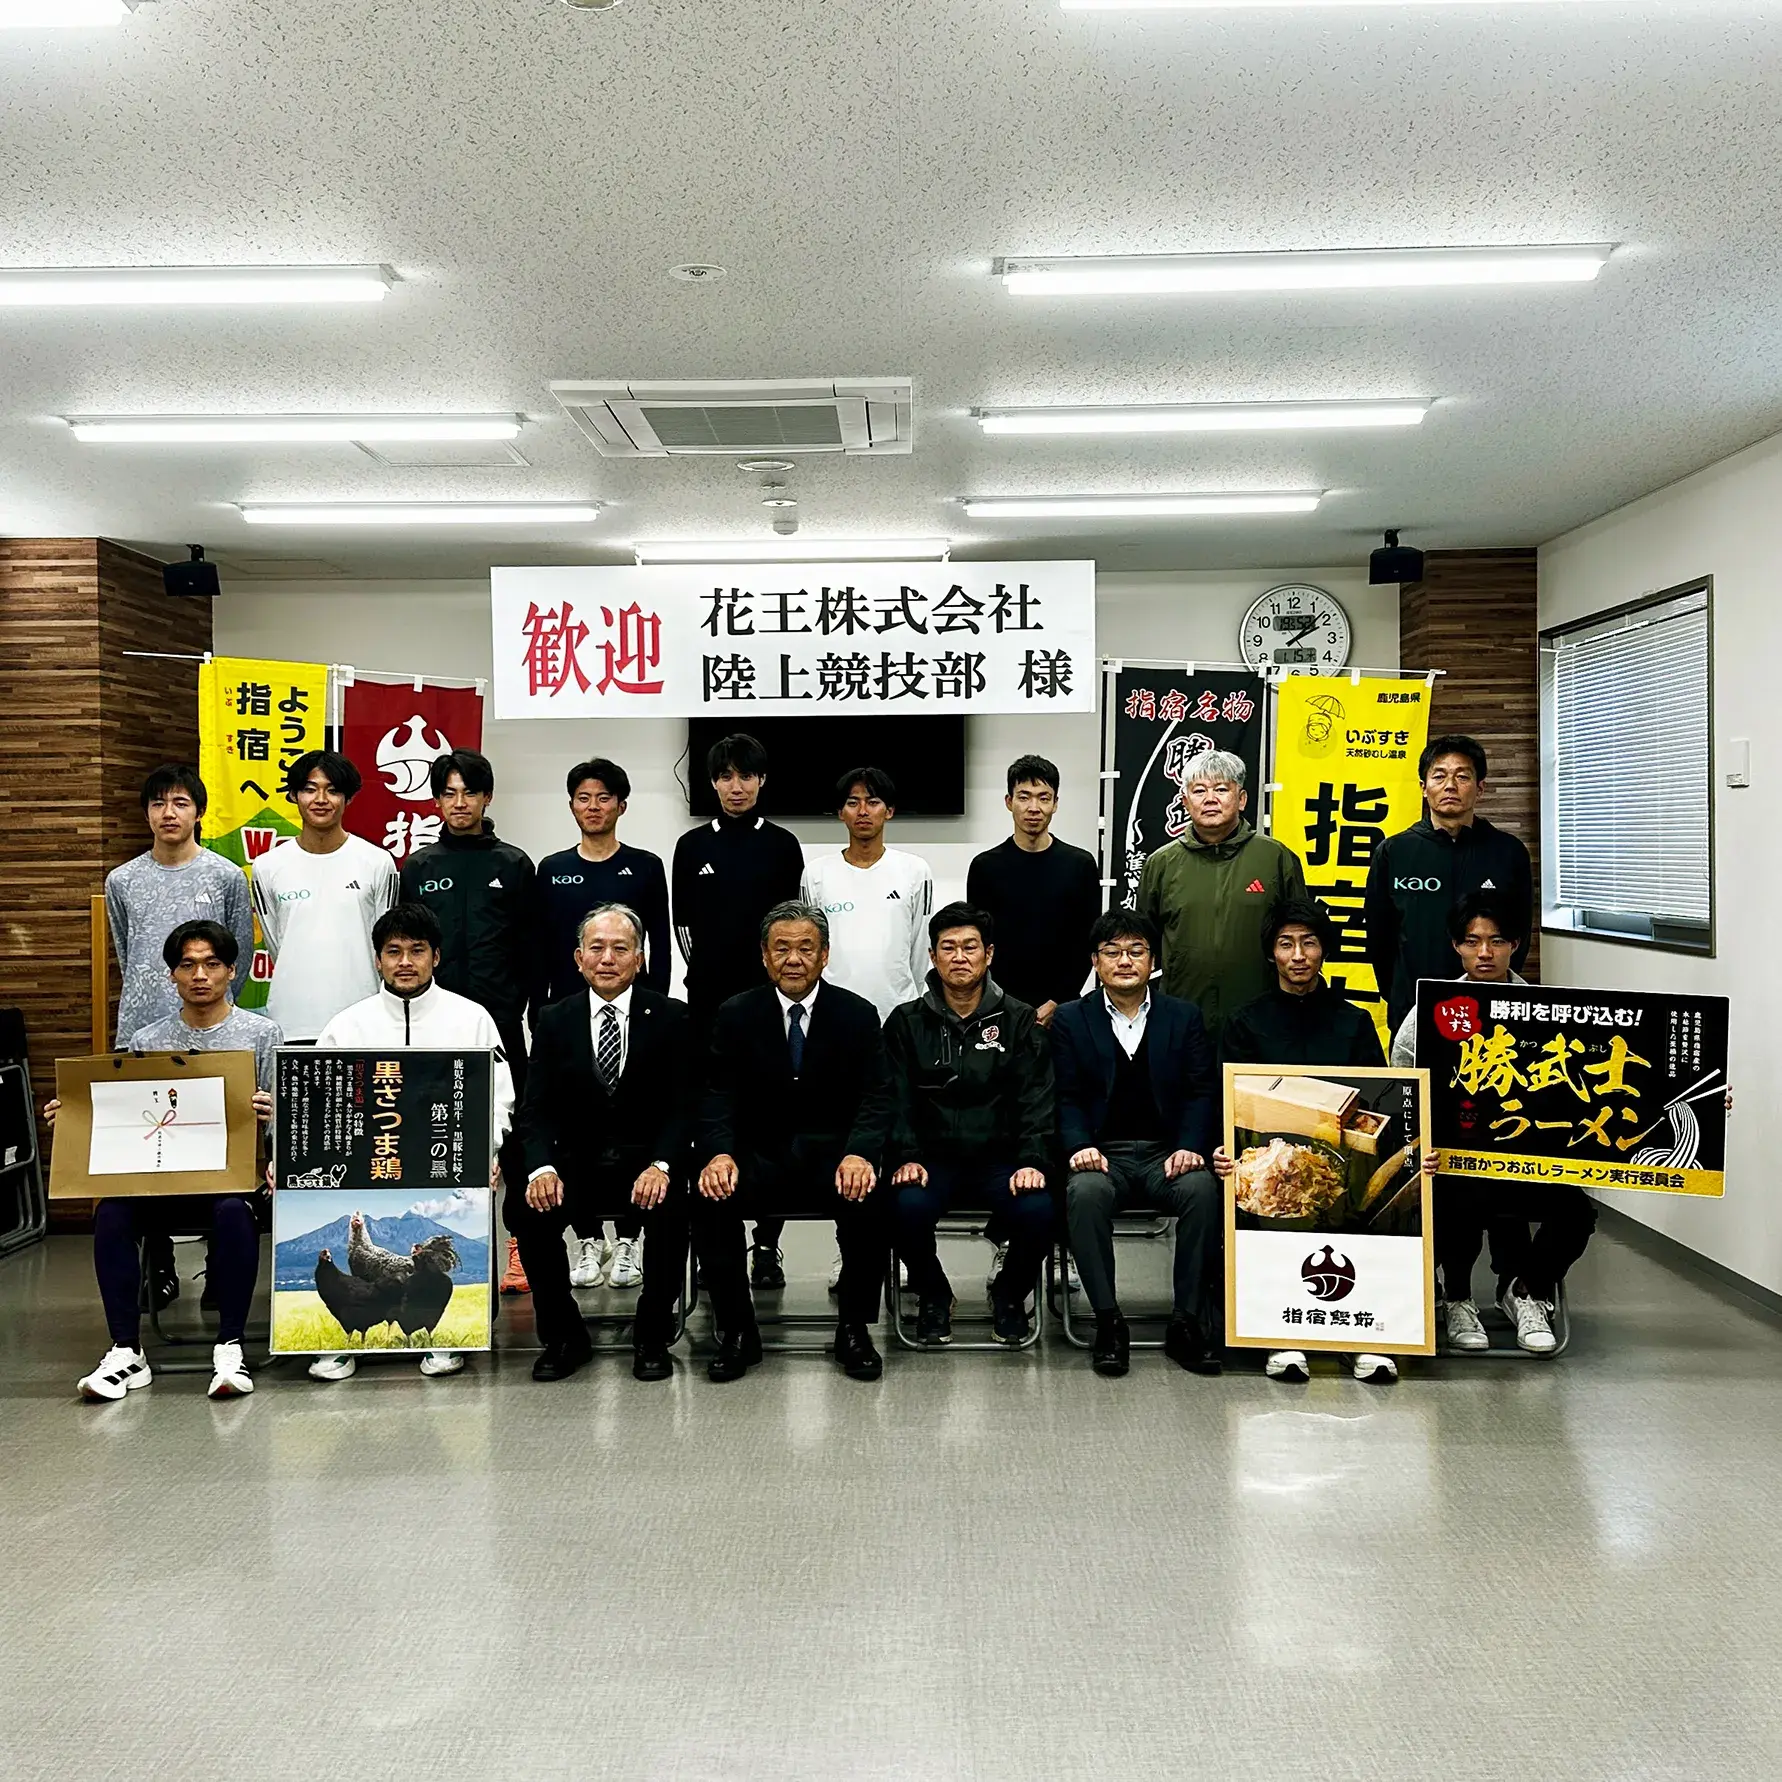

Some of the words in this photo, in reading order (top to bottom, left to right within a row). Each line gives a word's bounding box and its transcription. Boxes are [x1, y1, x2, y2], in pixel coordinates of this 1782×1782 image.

[699, 583, 1043, 637] 花王株式会社
[1270, 602, 1280, 615] 11
[1287, 596, 1301, 609] 12
[1310, 601, 1316, 613] 1
[1257, 616, 1271, 629] 10
[1322, 613, 1331, 626] 2
[521, 600, 665, 698] 歓迎
[1252, 634, 1263, 647] 9
[1327, 631, 1337, 644] 3
[1322, 650, 1333, 662] 4
[701, 651, 987, 703] 陸上競技部
[1017, 648, 1073, 700] 様
[1125, 688, 1255, 723] 指宿名物
[1376, 692, 1421, 704] 鹿児島県
[236, 681, 272, 802] 指宿へ
[1345, 729, 1410, 746] いぶすき
[1345, 748, 1407, 760] 天然砂むし温泉
[1449, 1024, 1652, 1103] 勝武士
[370, 1060, 404, 1182] 黒さつま鶏
[452, 1058, 465, 1183] 鹿児島の黒牛・黒豚に続く
[1402, 1085, 1414, 1174] 原点にして頂点。
[1488, 1098, 1665, 1151] ラーメン
[429, 1102, 449, 1179] 第三の黒
[1448, 1155, 1685, 1188] 指宿かつおぶしラーメン実行委員会
[1282, 1307, 1375, 1329] 指宿鰹節
